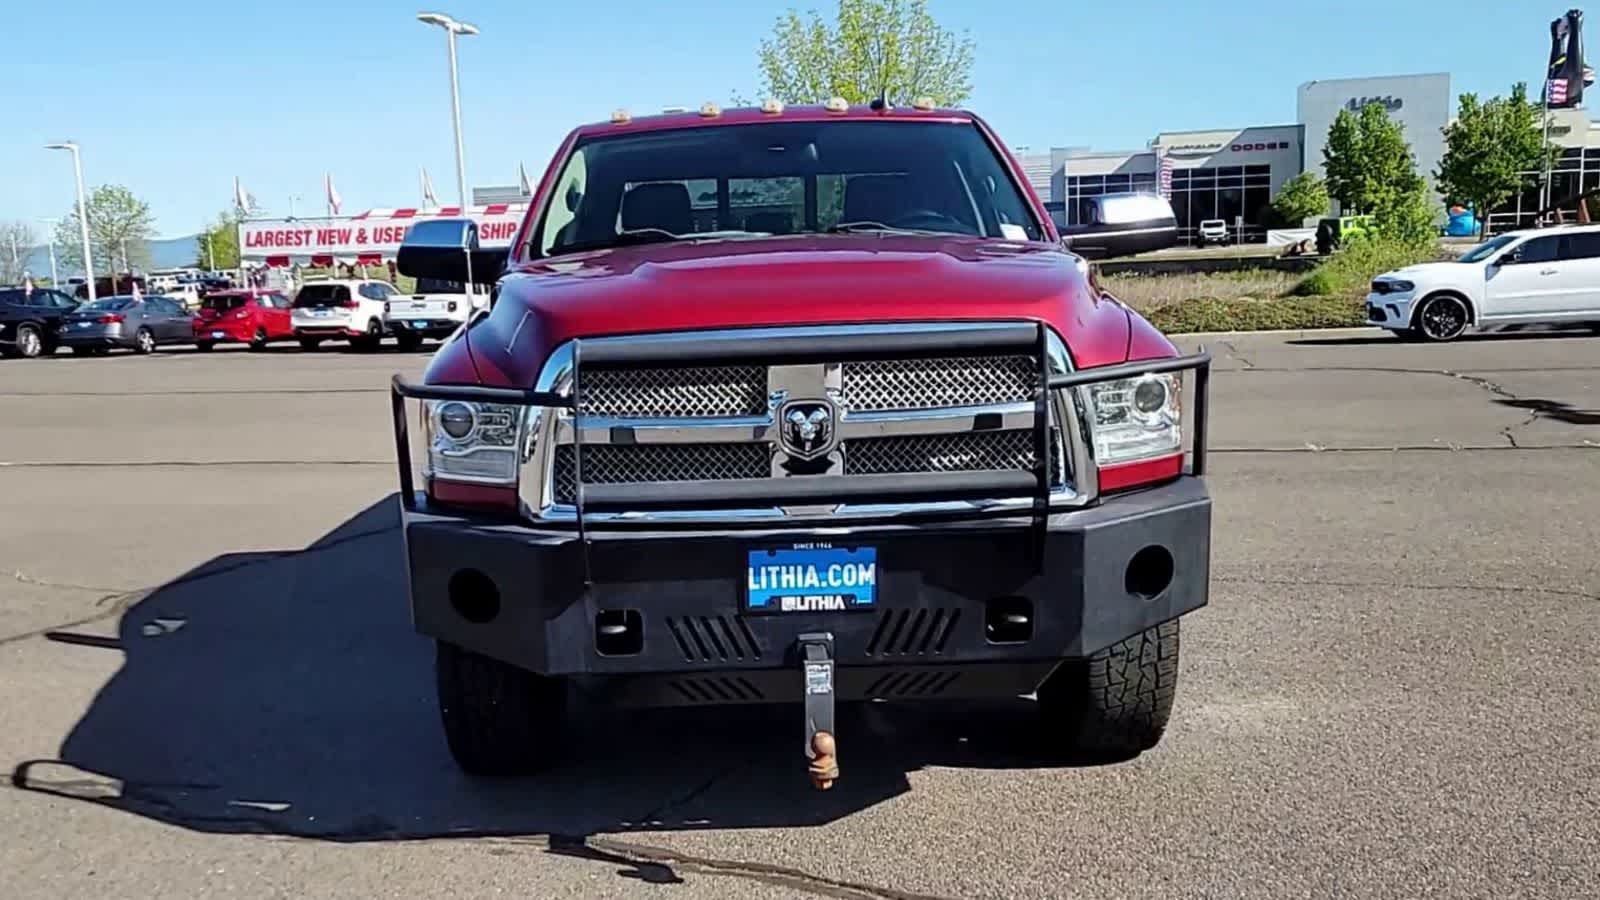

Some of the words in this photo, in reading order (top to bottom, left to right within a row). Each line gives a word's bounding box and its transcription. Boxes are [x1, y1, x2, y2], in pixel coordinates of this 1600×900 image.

[245, 230, 313, 247] LARGEST
[316, 227, 352, 245] NEW
[355, 228, 368, 243] &
[373, 225, 410, 244] USE
[480, 222, 517, 240] SHIP
[748, 563, 876, 590] LITHIA.COM
[797, 595, 846, 611] LITHIA
